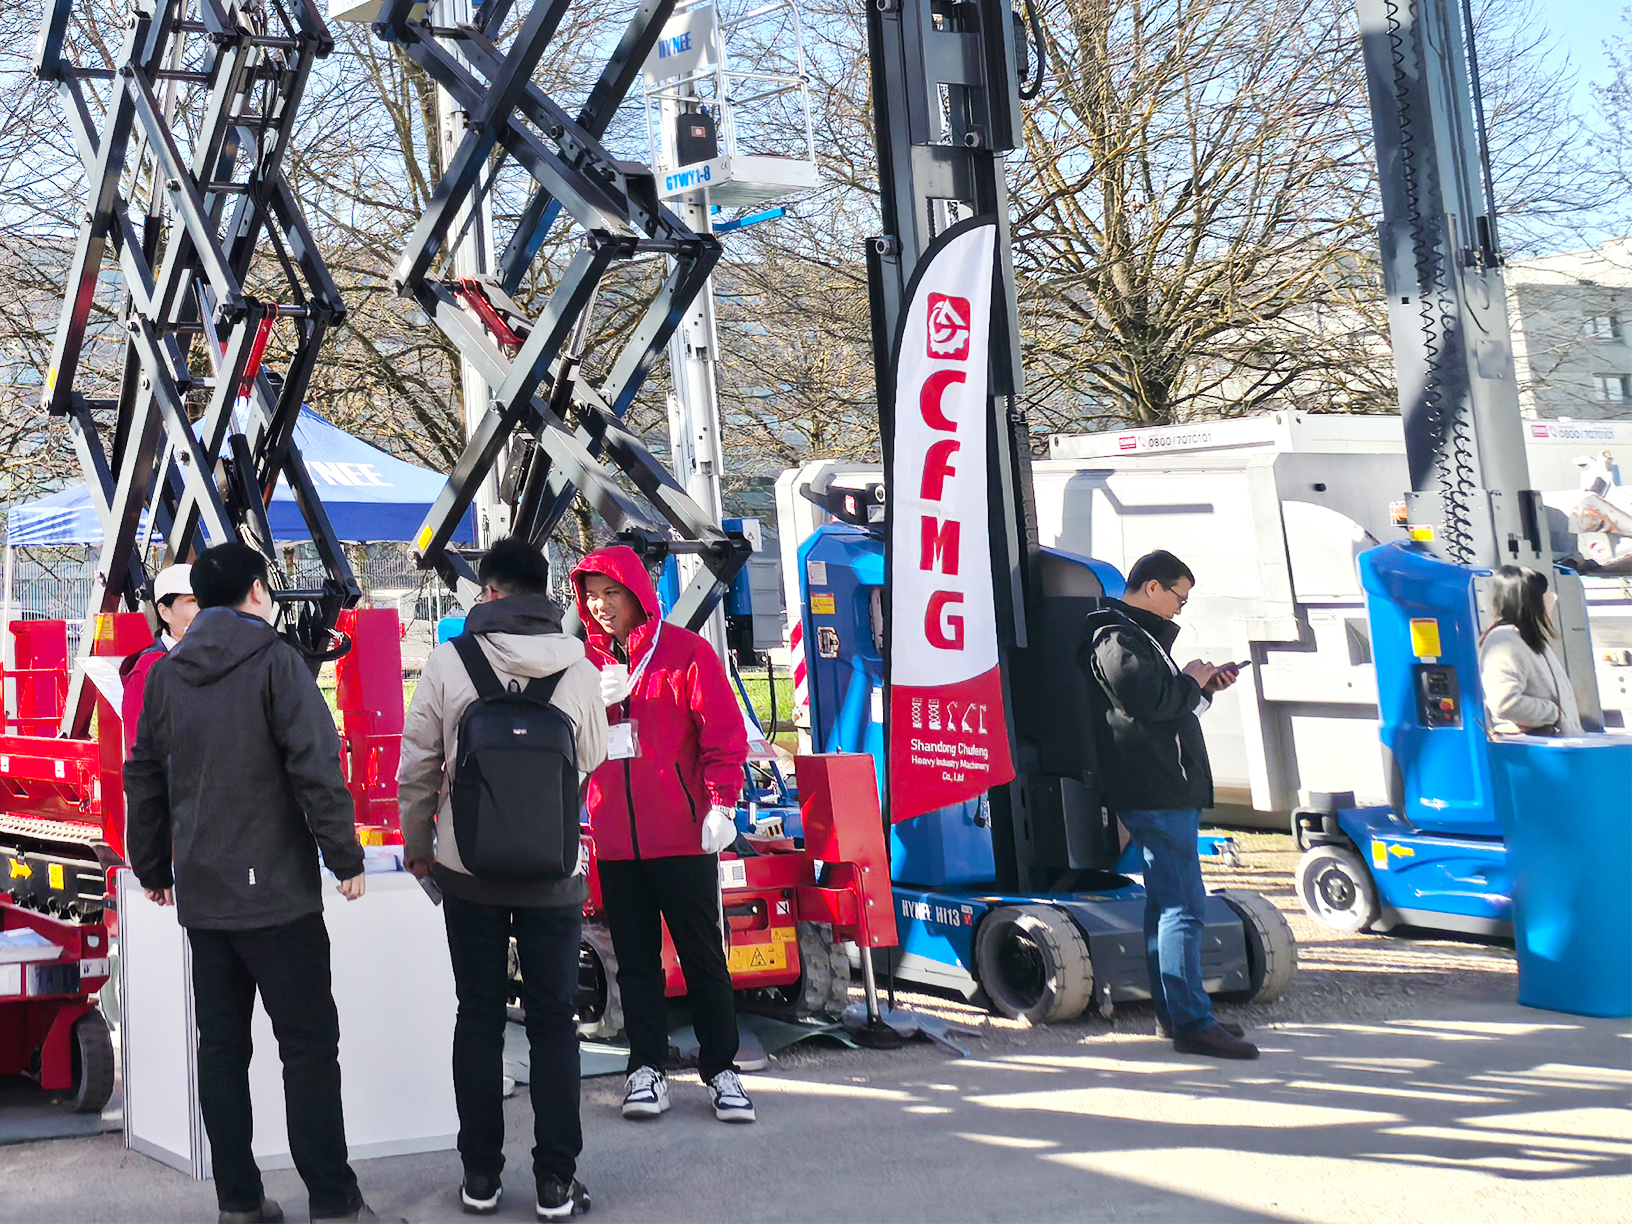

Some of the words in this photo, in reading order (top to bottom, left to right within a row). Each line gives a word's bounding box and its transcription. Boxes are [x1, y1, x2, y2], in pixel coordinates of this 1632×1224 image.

[919, 369, 967, 651] CFMG
[910, 738, 956, 756] Shandong
[958, 742, 988, 760] Chufeng
[911, 755, 935, 767] Heavy
[936, 757, 959, 769] Industry
[960, 759, 989, 772] Machinery
